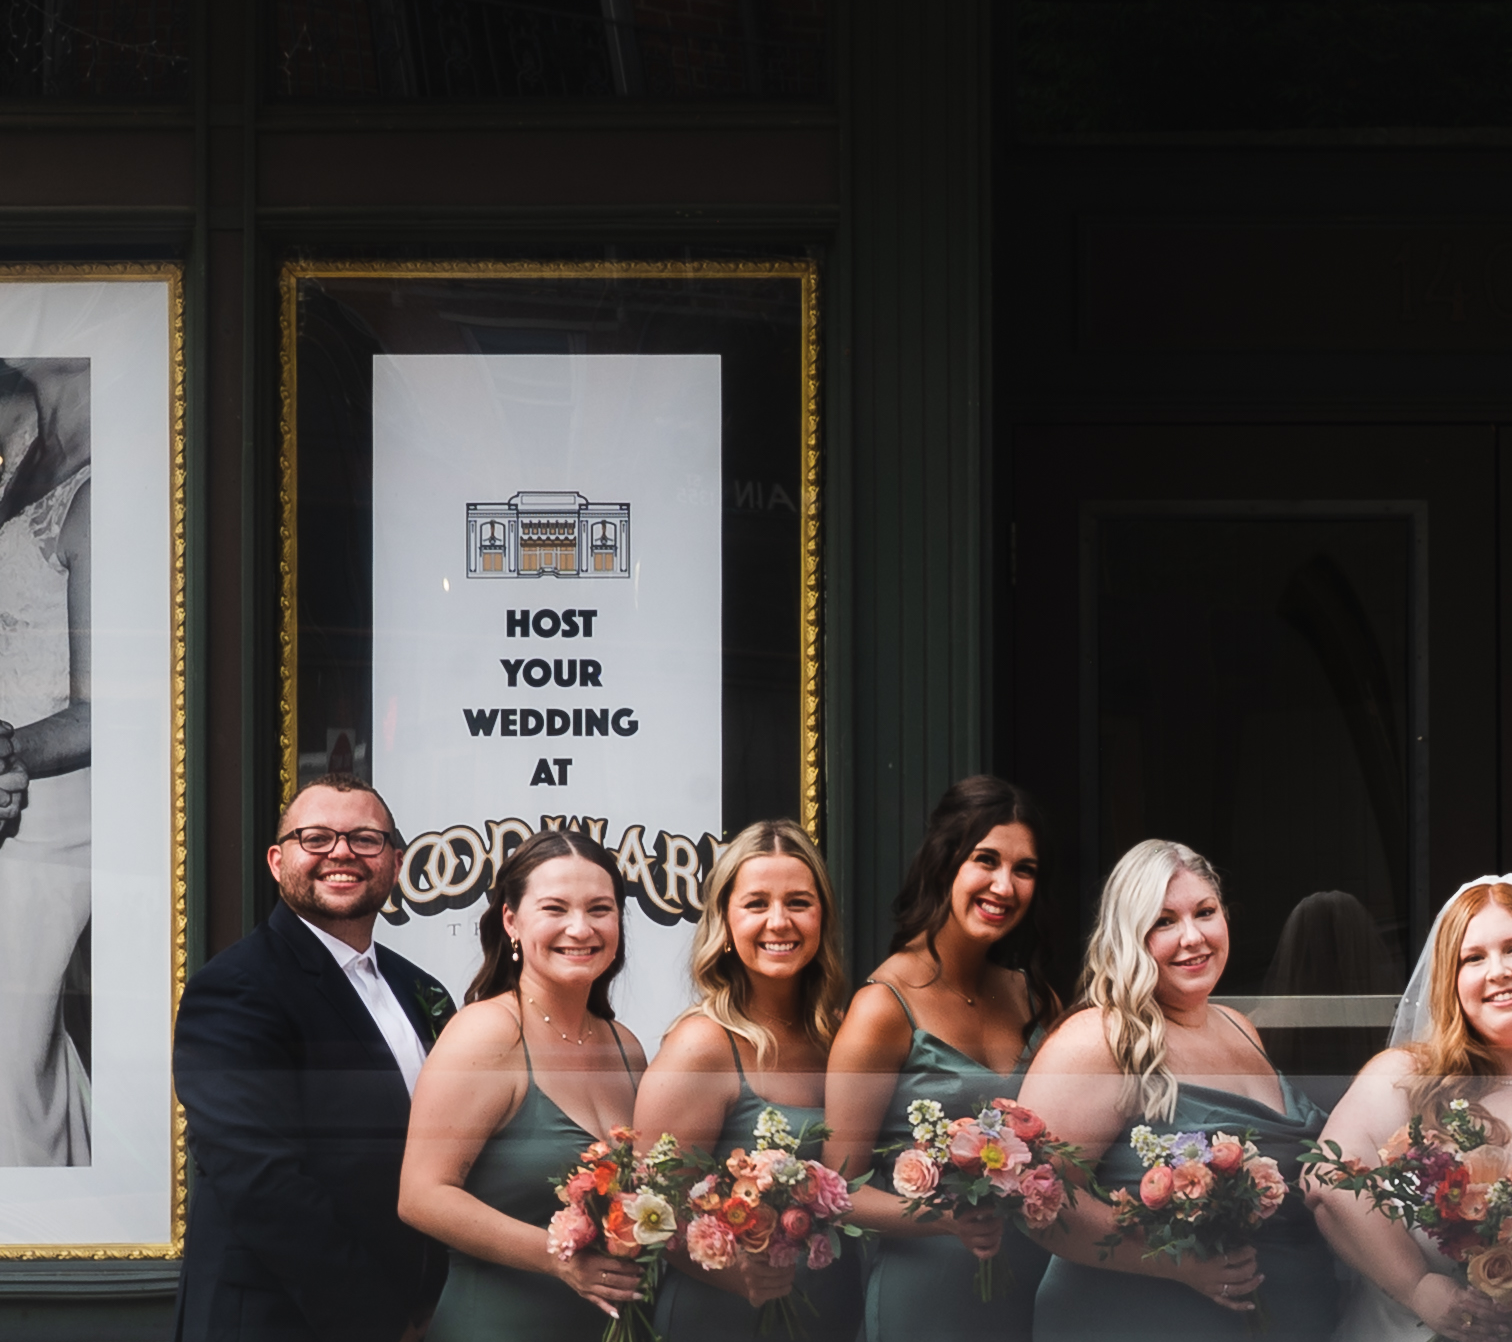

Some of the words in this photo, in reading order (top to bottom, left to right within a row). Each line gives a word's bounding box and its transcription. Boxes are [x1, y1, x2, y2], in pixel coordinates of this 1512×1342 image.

[506, 609, 597, 638] HOST
[500, 658, 602, 688] YOUR
[462, 708, 639, 737] WEDDING
[529, 758, 573, 787] AT
